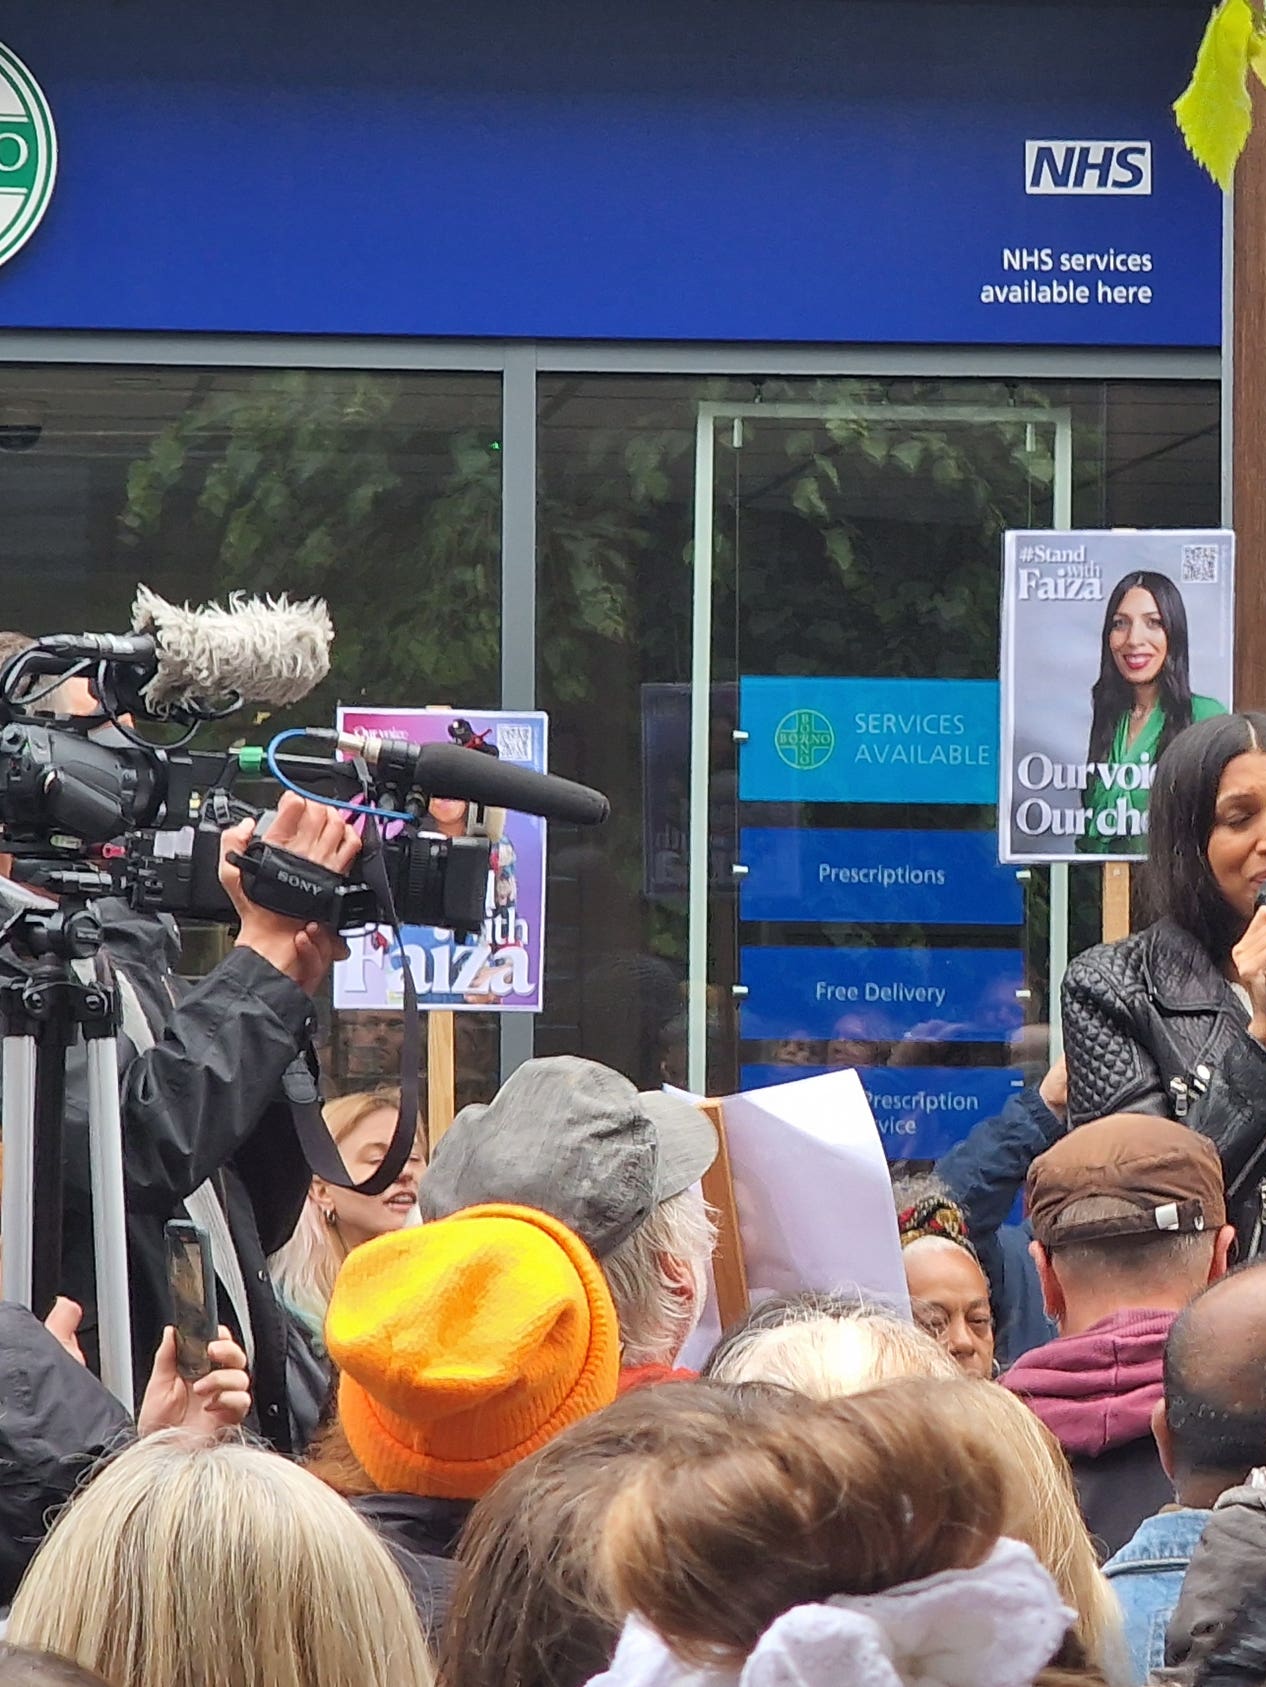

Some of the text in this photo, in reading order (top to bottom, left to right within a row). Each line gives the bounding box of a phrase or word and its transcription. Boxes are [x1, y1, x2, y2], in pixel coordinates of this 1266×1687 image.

[1030, 146, 1146, 188] NHS
[1003, 248, 1152, 271] NHS services
[980, 279, 1152, 303] available here
[1019, 545, 1086, 563] #Stand
[1066, 560, 1100, 578] with
[1018, 567, 1103, 600] Faiza
[854, 713, 965, 735] SERVICES
[854, 743, 990, 765] AVAILABLE
[1017, 752, 1095, 790] Our
[1015, 797, 1093, 835] Our
[277, 870, 322, 896] SONY
[819, 863, 945, 888] Prescriptions
[484, 906, 529, 945] ith
[816, 981, 946, 1007] Free Delivery
[878, 1116, 917, 1134] vice
